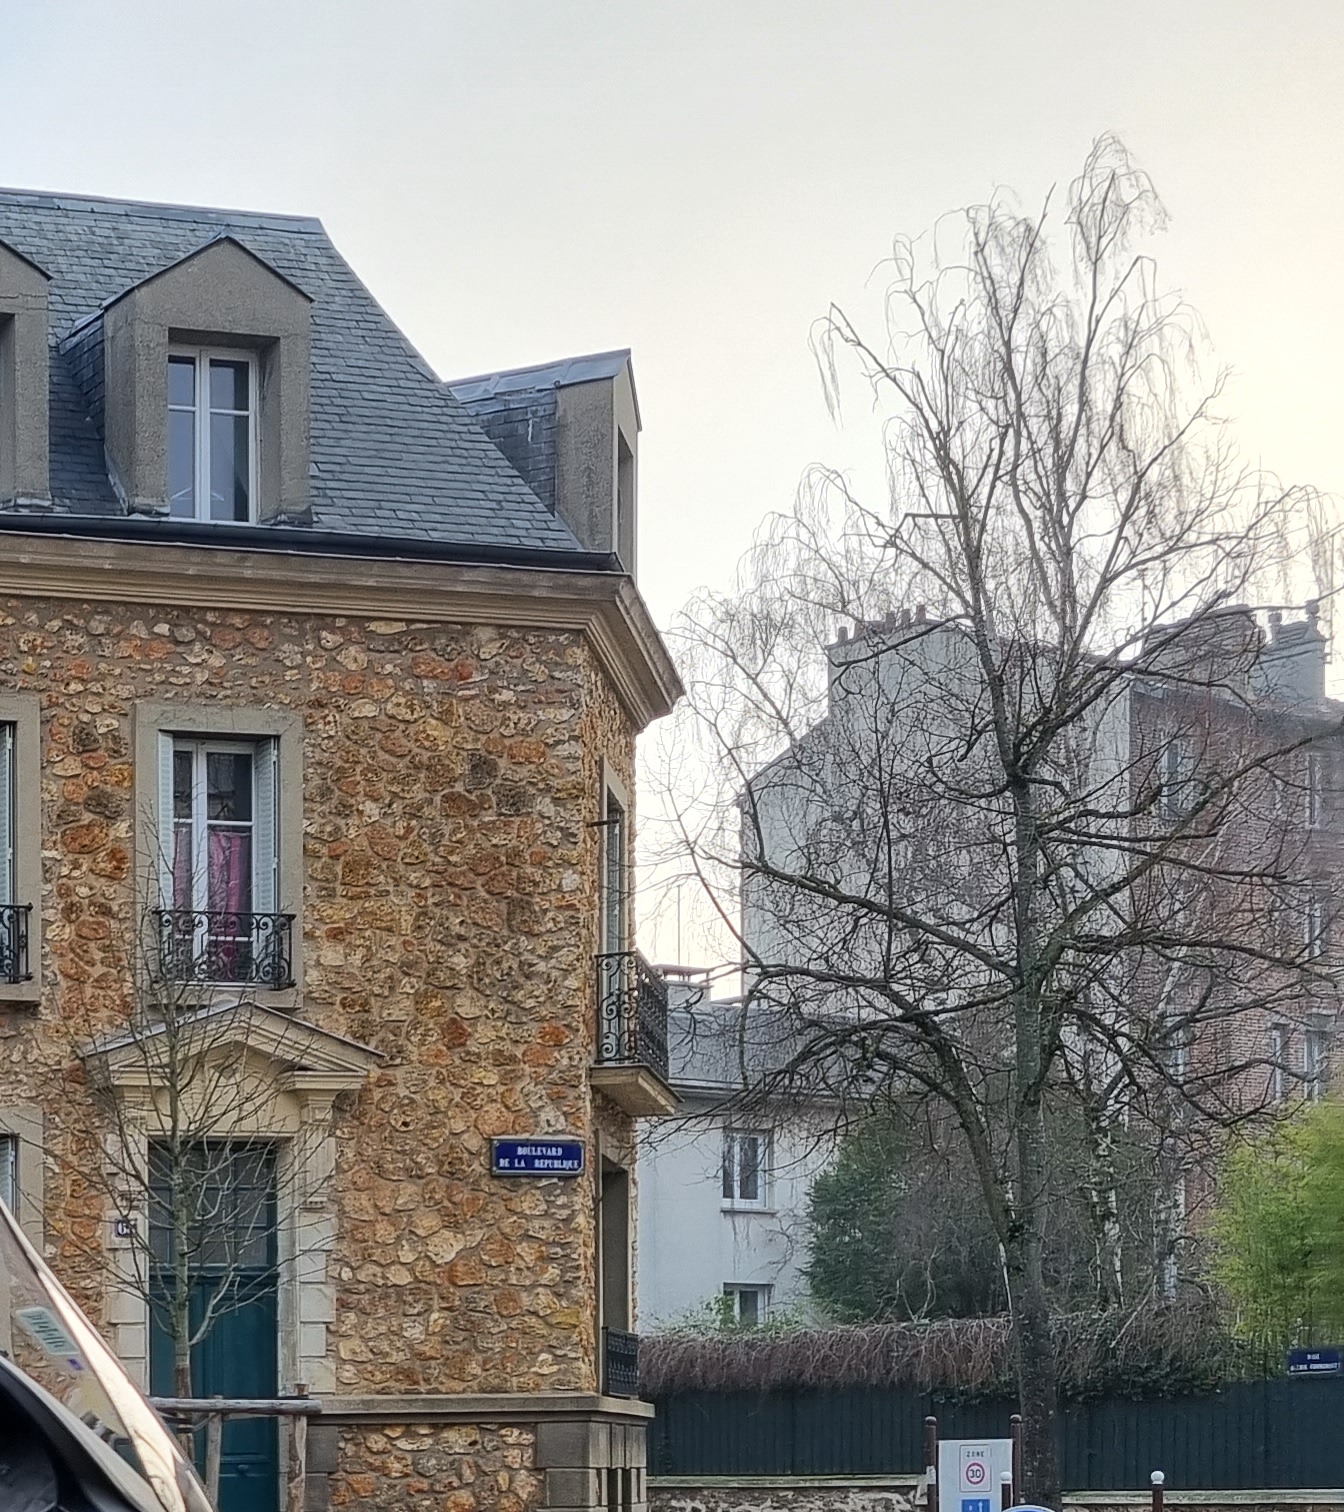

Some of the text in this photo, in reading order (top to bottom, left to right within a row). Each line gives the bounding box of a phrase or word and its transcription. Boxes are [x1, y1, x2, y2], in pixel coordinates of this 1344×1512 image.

[517, 1146, 563, 1156] BOULEVARD
[499, 1158, 510, 1167] DE
[514, 1158, 526, 1167] LA
[969, 1468, 982, 1479] 30
